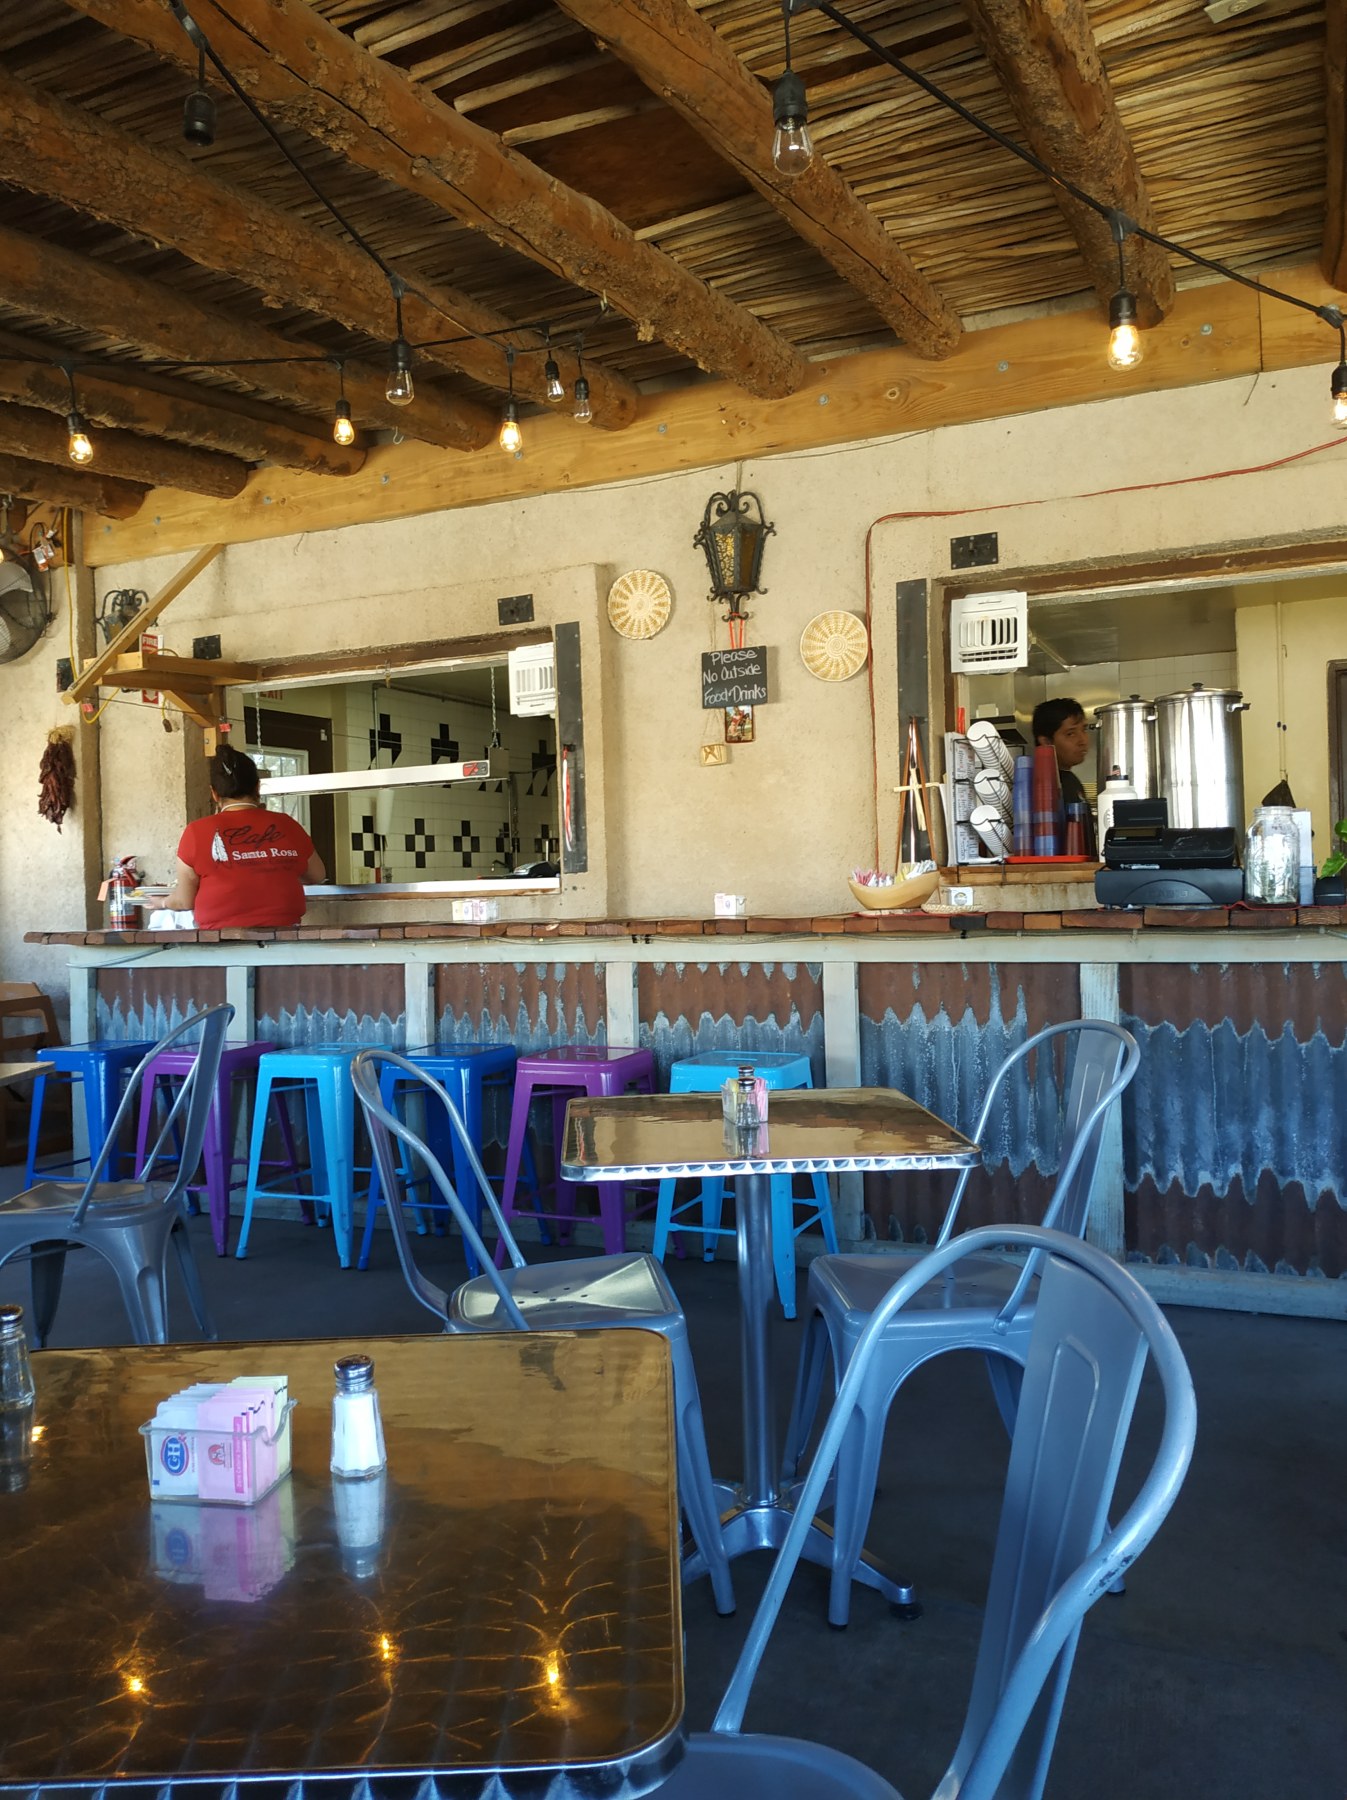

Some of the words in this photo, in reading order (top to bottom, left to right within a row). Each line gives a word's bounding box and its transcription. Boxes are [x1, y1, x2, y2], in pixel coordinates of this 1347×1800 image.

[710, 650, 758, 666] Please
[703, 669, 718, 685] No
[720, 663, 762, 681] Outside
[704, 687, 729, 706] Food
[231, 848, 268, 861] Santa
[269, 846, 299, 858] Rosa
